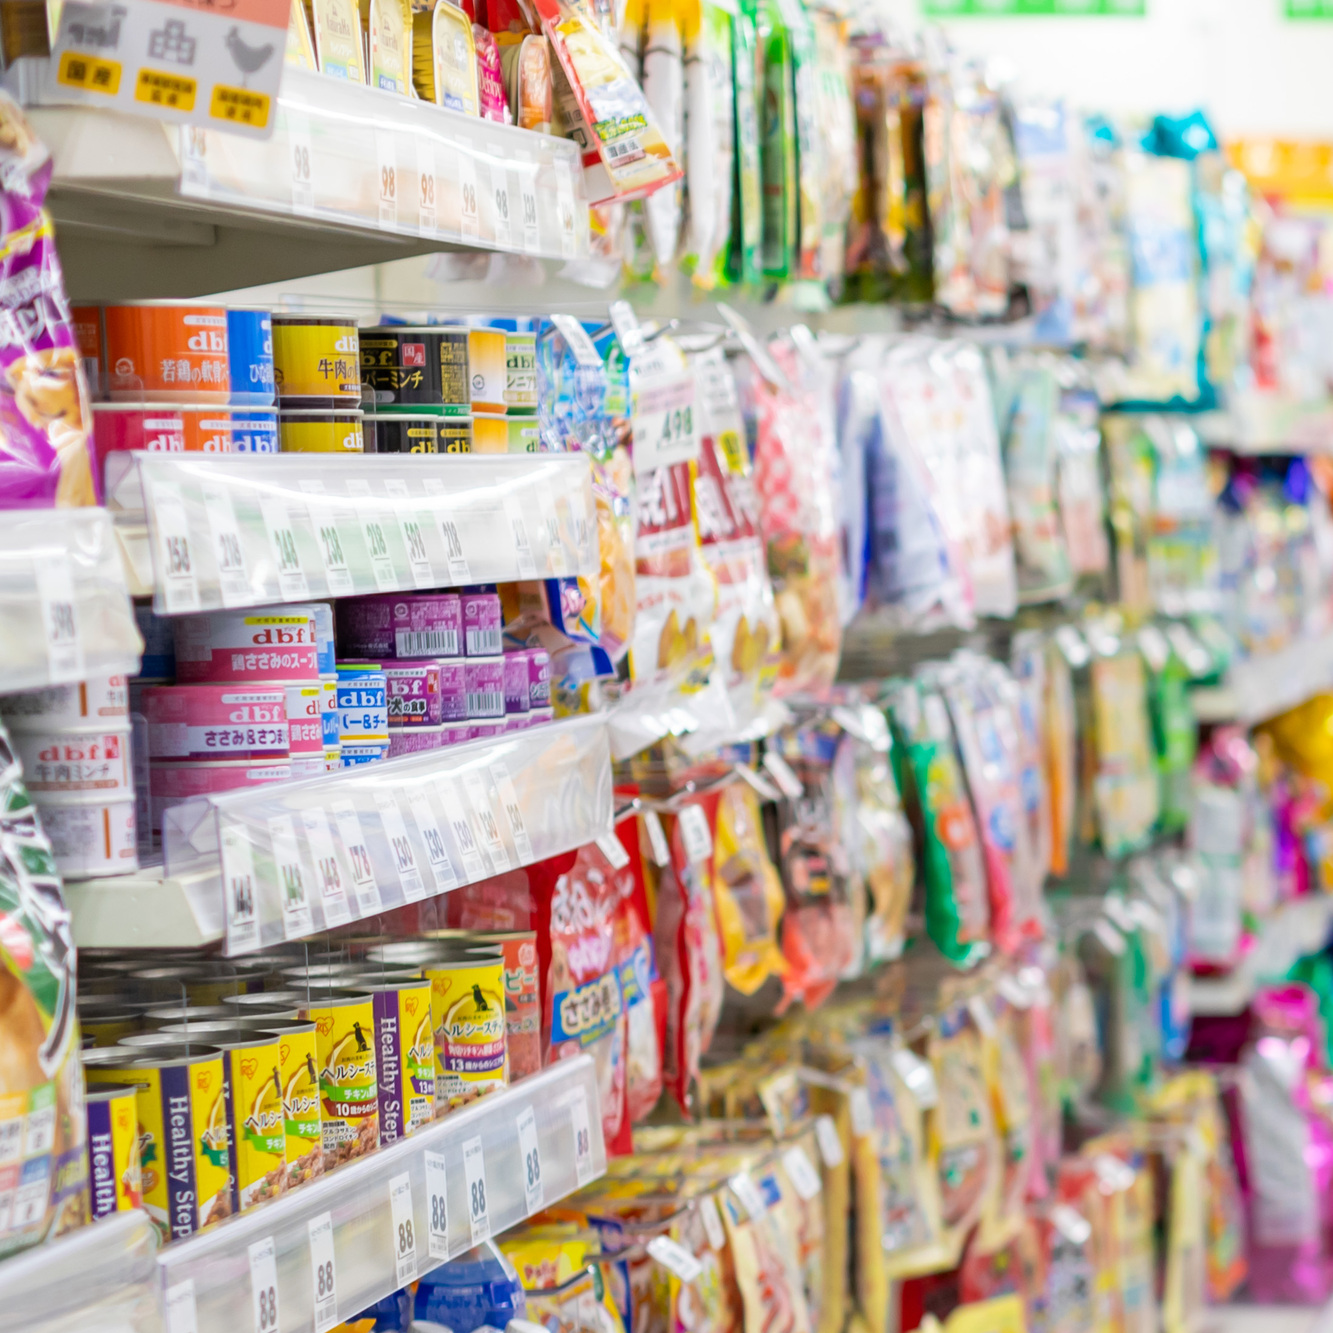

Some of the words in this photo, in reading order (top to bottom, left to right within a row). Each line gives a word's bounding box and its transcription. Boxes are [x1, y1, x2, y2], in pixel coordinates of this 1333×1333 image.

[380, 1016, 399, 1096] Healthy
[168, 1096, 194, 1184] Healthy
[381, 1100, 401, 1144] Step
[577, 1128, 589, 1156] 88
[525, 1147, 540, 1183] 88
[172, 1189, 195, 1239] Step
[431, 1193, 447, 1232] 88
[471, 1178, 486, 1216] 88
[398, 1219, 414, 1253] 88
[317, 1260, 334, 1298] 88
[259, 1286, 276, 1331] 88
